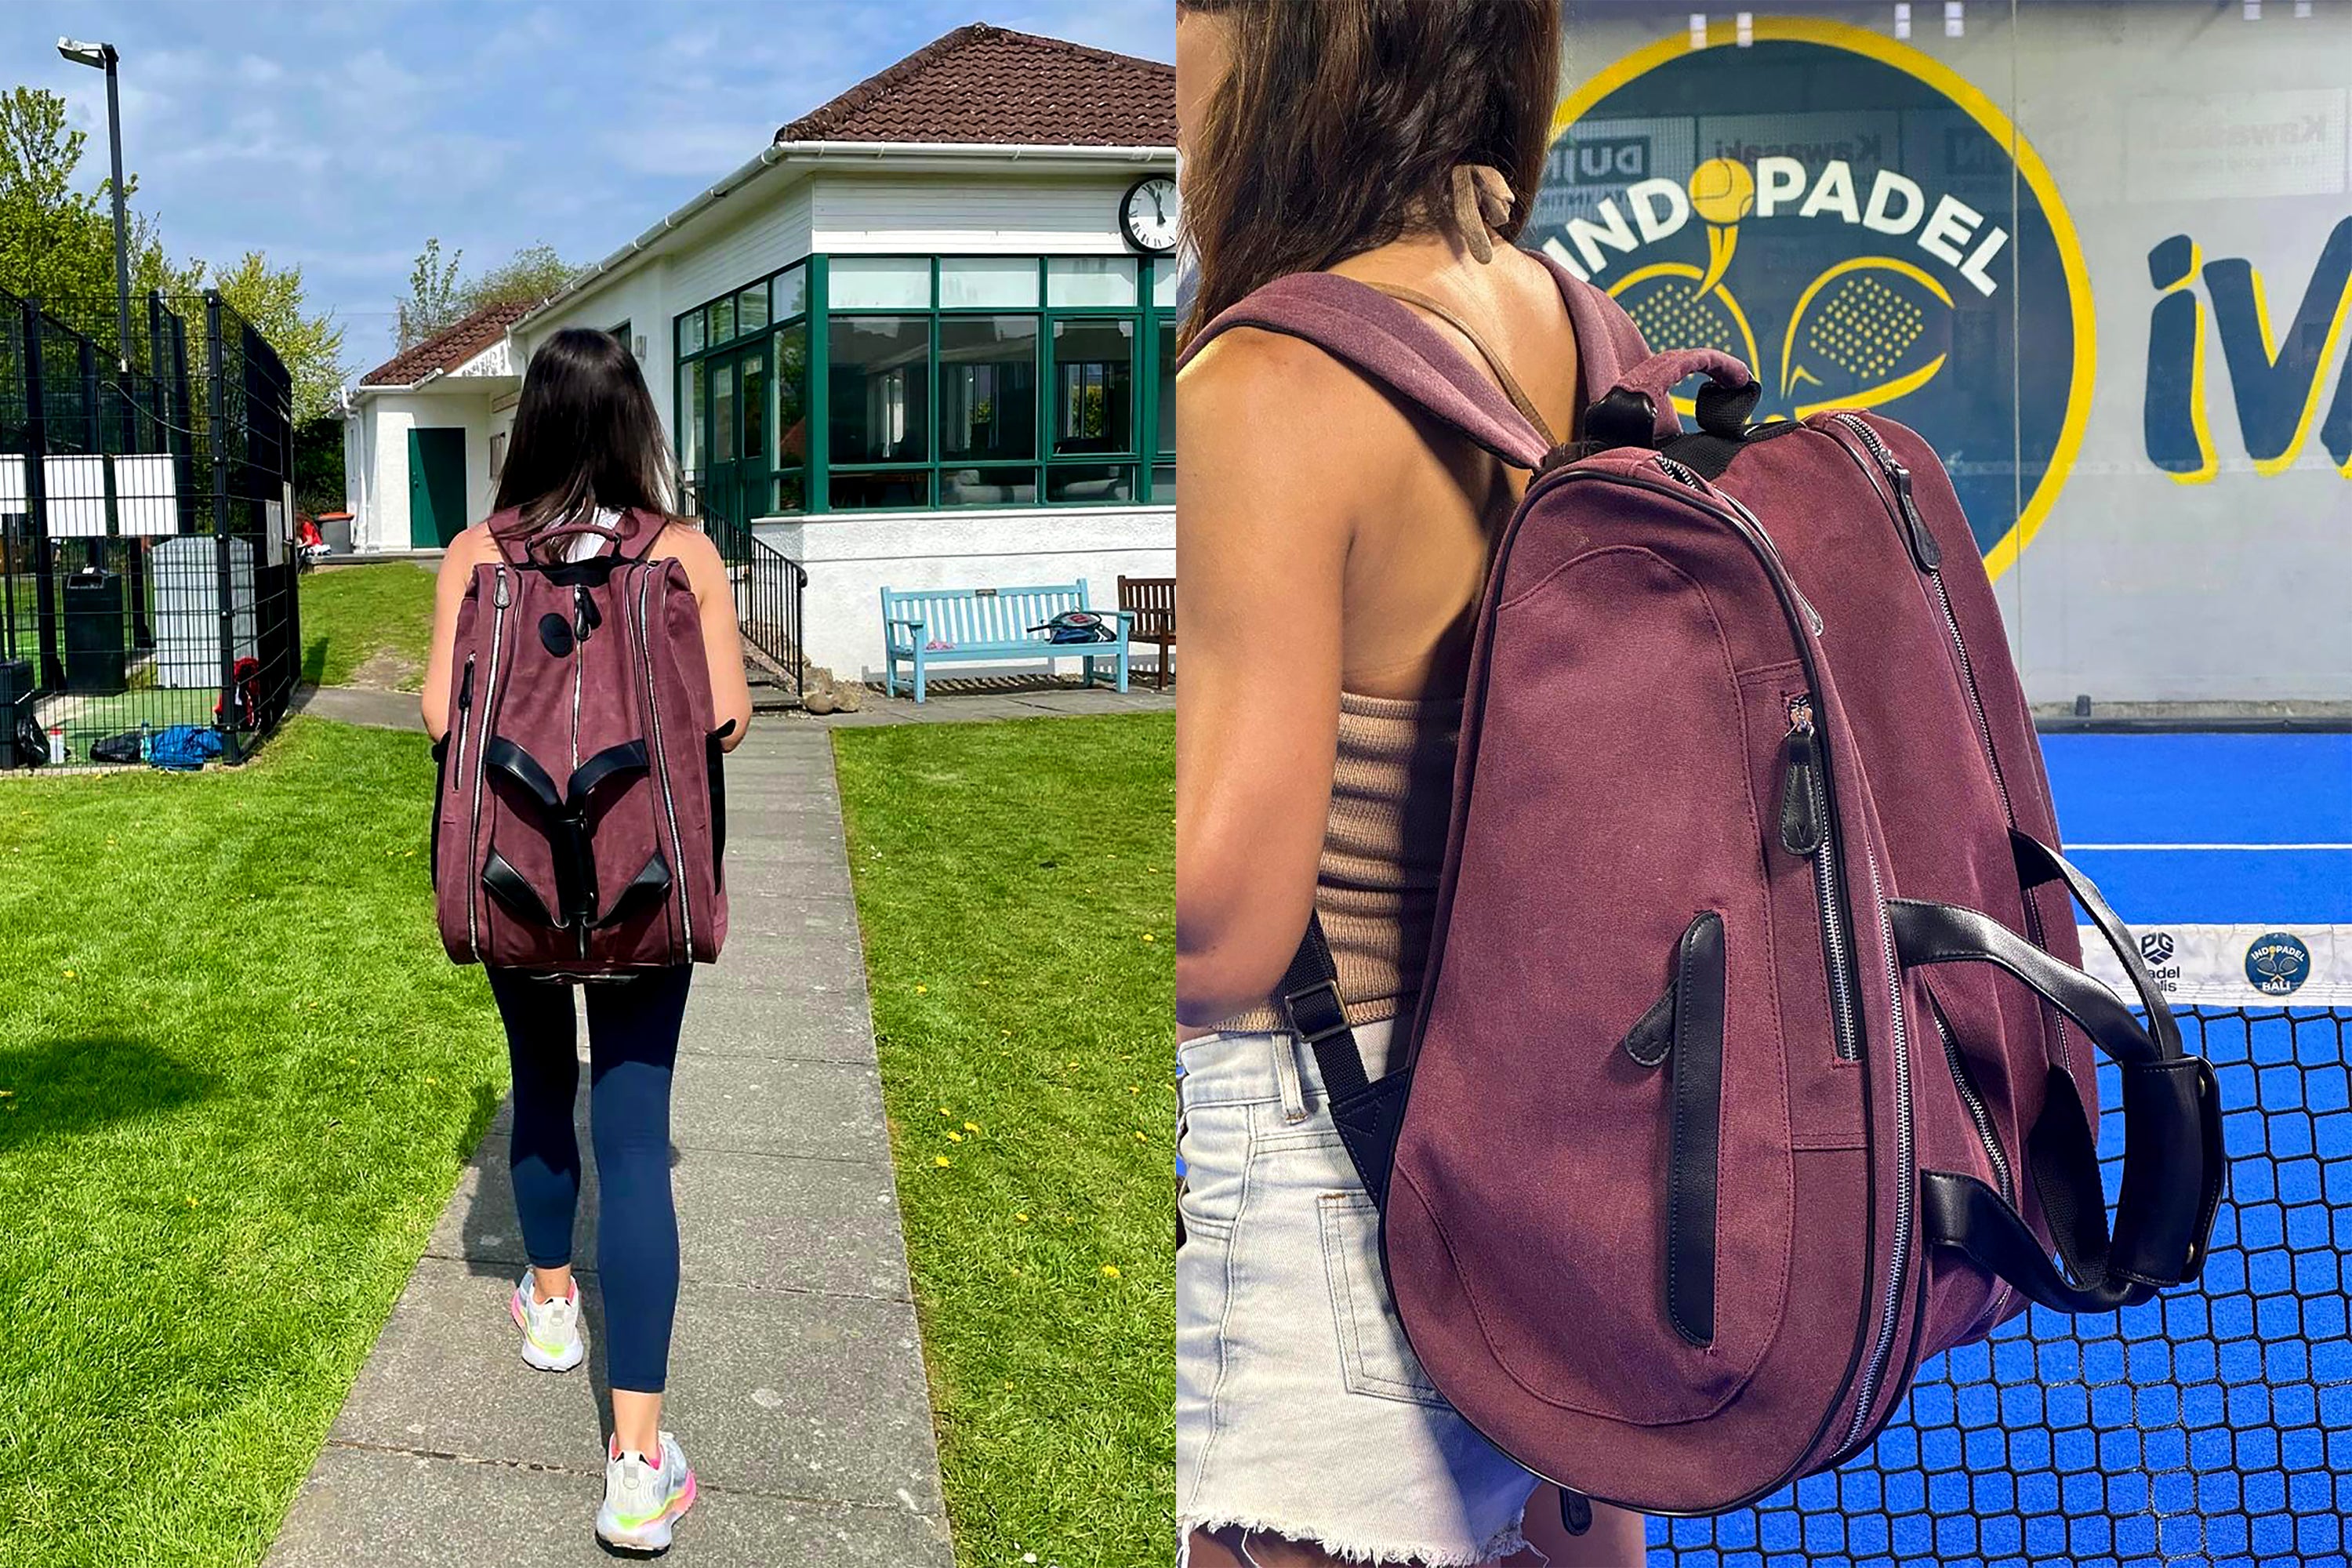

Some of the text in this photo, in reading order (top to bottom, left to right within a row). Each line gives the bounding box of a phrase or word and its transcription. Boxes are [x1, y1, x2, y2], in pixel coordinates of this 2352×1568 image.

[2141, 931, 2174, 954] PG
[2147, 965, 2180, 979] adel
[2262, 980, 2291, 992] BALI
